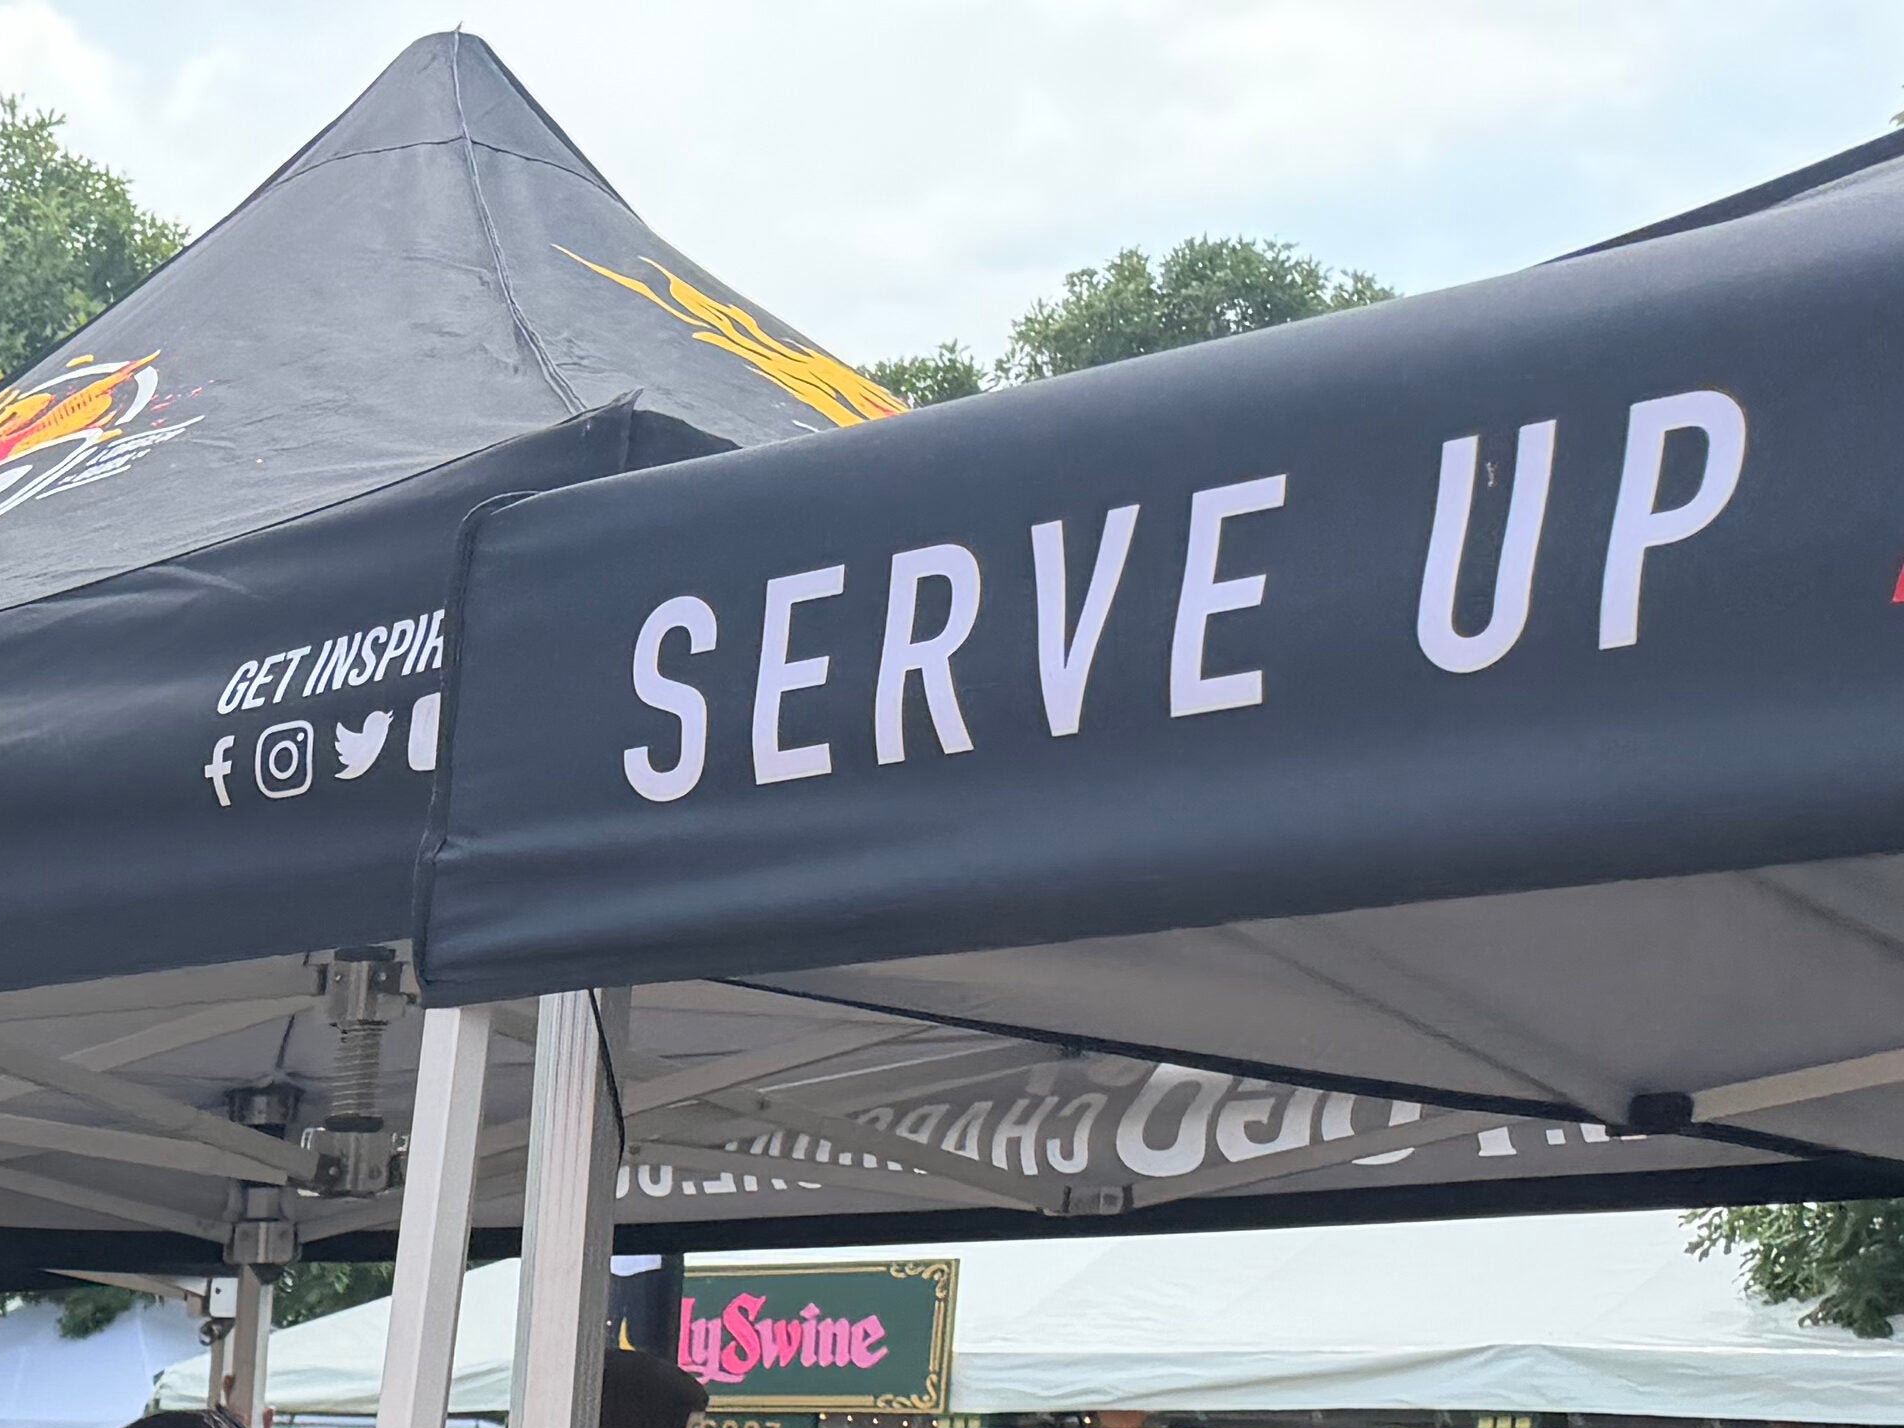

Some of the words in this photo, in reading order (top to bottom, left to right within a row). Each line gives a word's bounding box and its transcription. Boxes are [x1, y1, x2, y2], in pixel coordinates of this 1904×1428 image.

[216, 645, 312, 715] GET
[622, 473, 1290, 803] SERVE
[1415, 389, 1748, 676] UP
